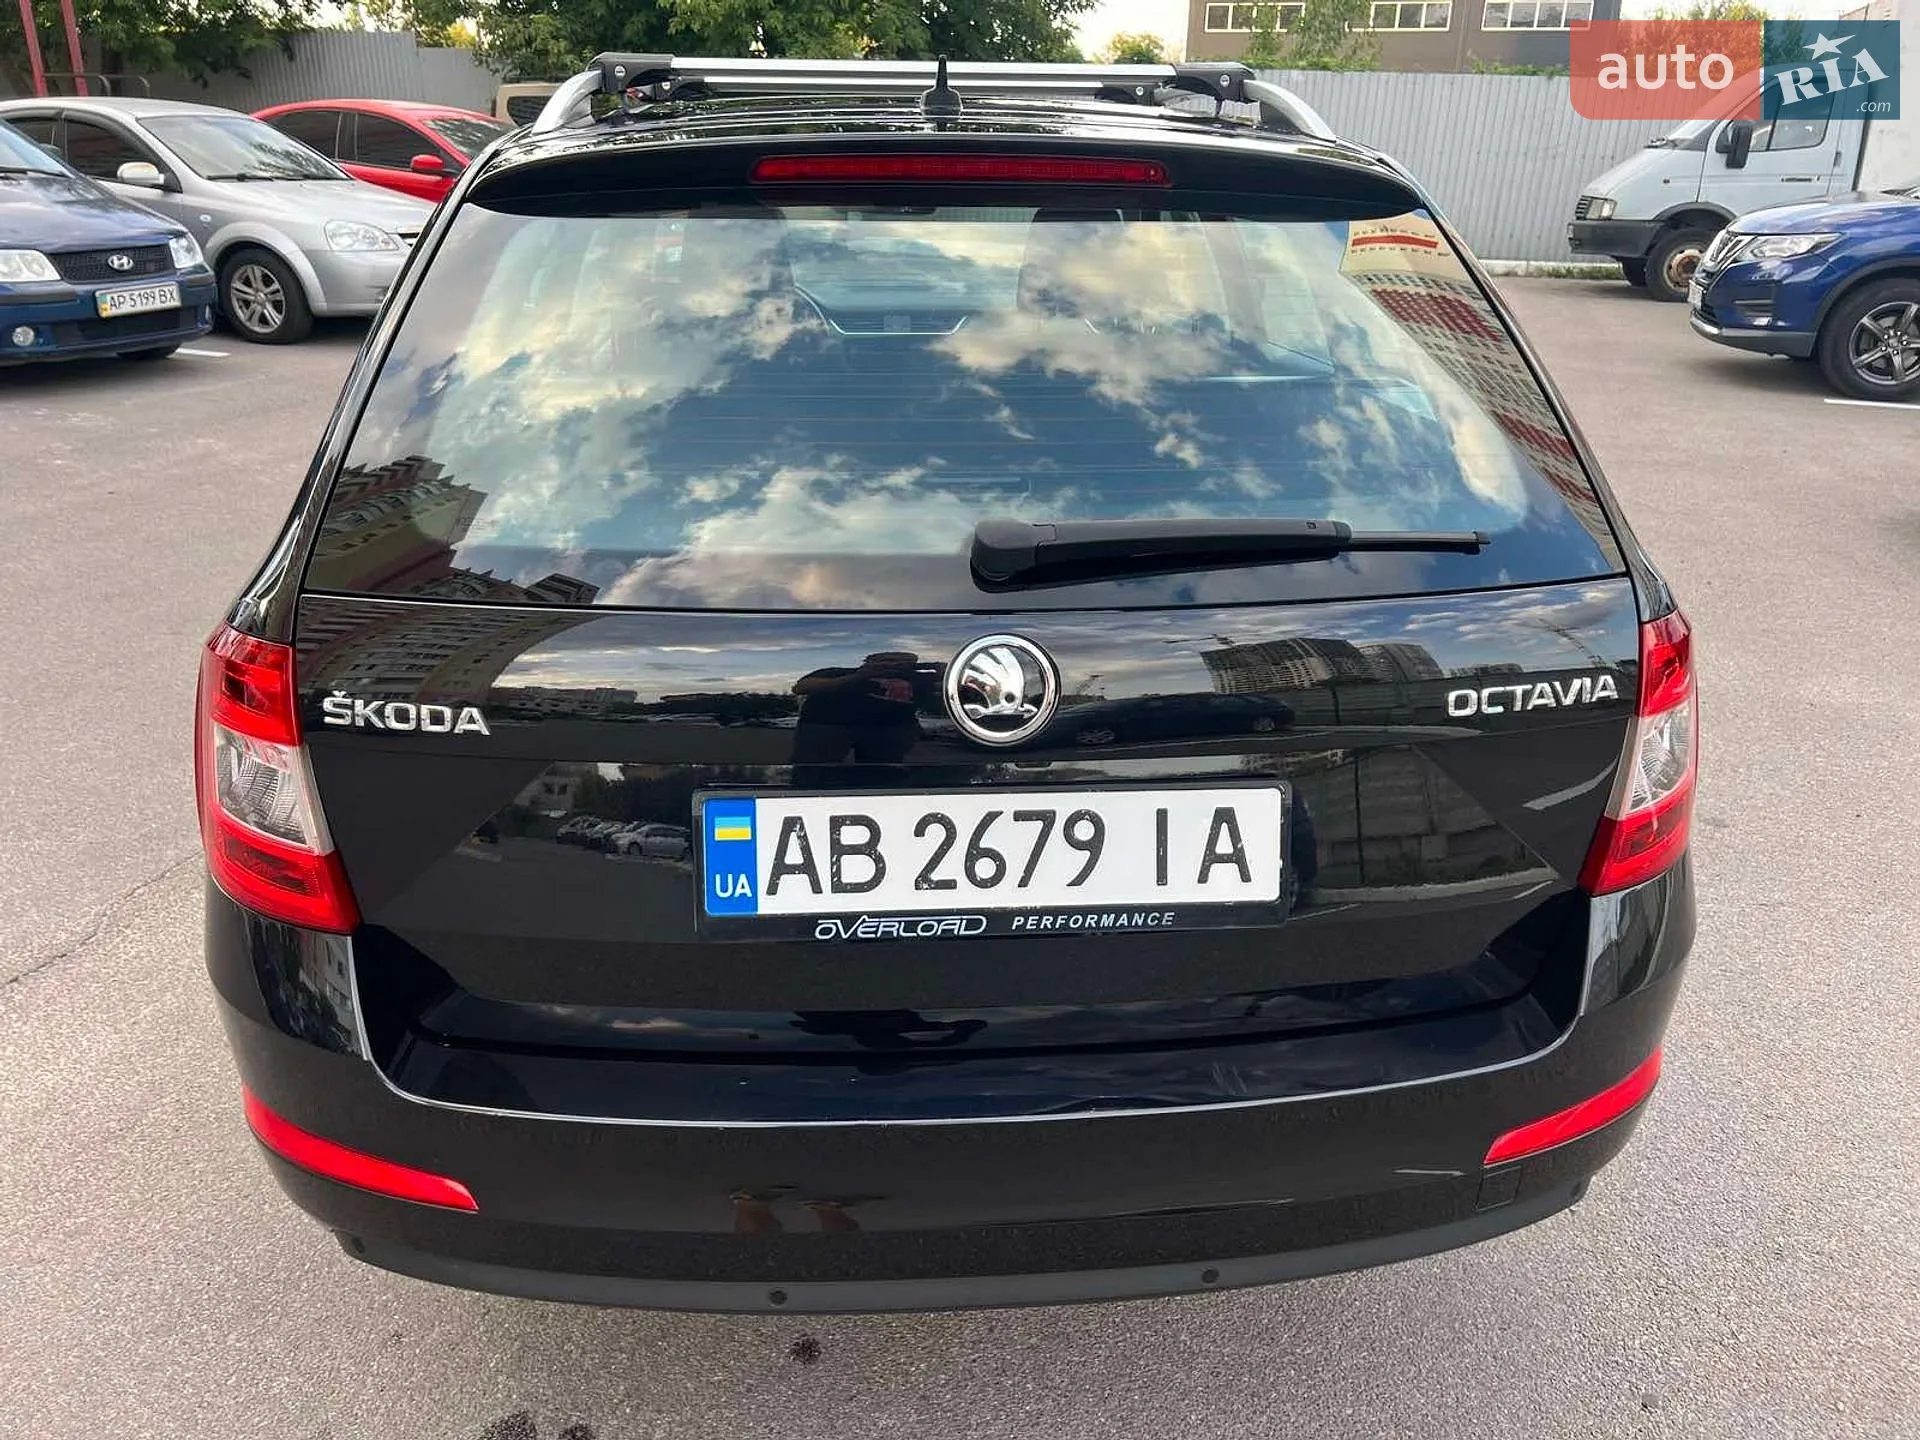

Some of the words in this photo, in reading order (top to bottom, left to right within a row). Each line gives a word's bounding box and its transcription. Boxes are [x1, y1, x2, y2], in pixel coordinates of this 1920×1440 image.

[109, 294, 126, 310] AP
[128, 290, 157, 308] 5199
[158, 287, 176, 304] BX
[322, 690, 491, 736] ŠKODA
[1447, 674, 1619, 717] OCTAVIA
[765, 813, 887, 895] AB
[913, 808, 1106, 891] 2679
[714, 873, 753, 898] UA
[814, 914, 988, 939] OVERLOAD
[1012, 911, 1176, 930] PERFORMANCE
